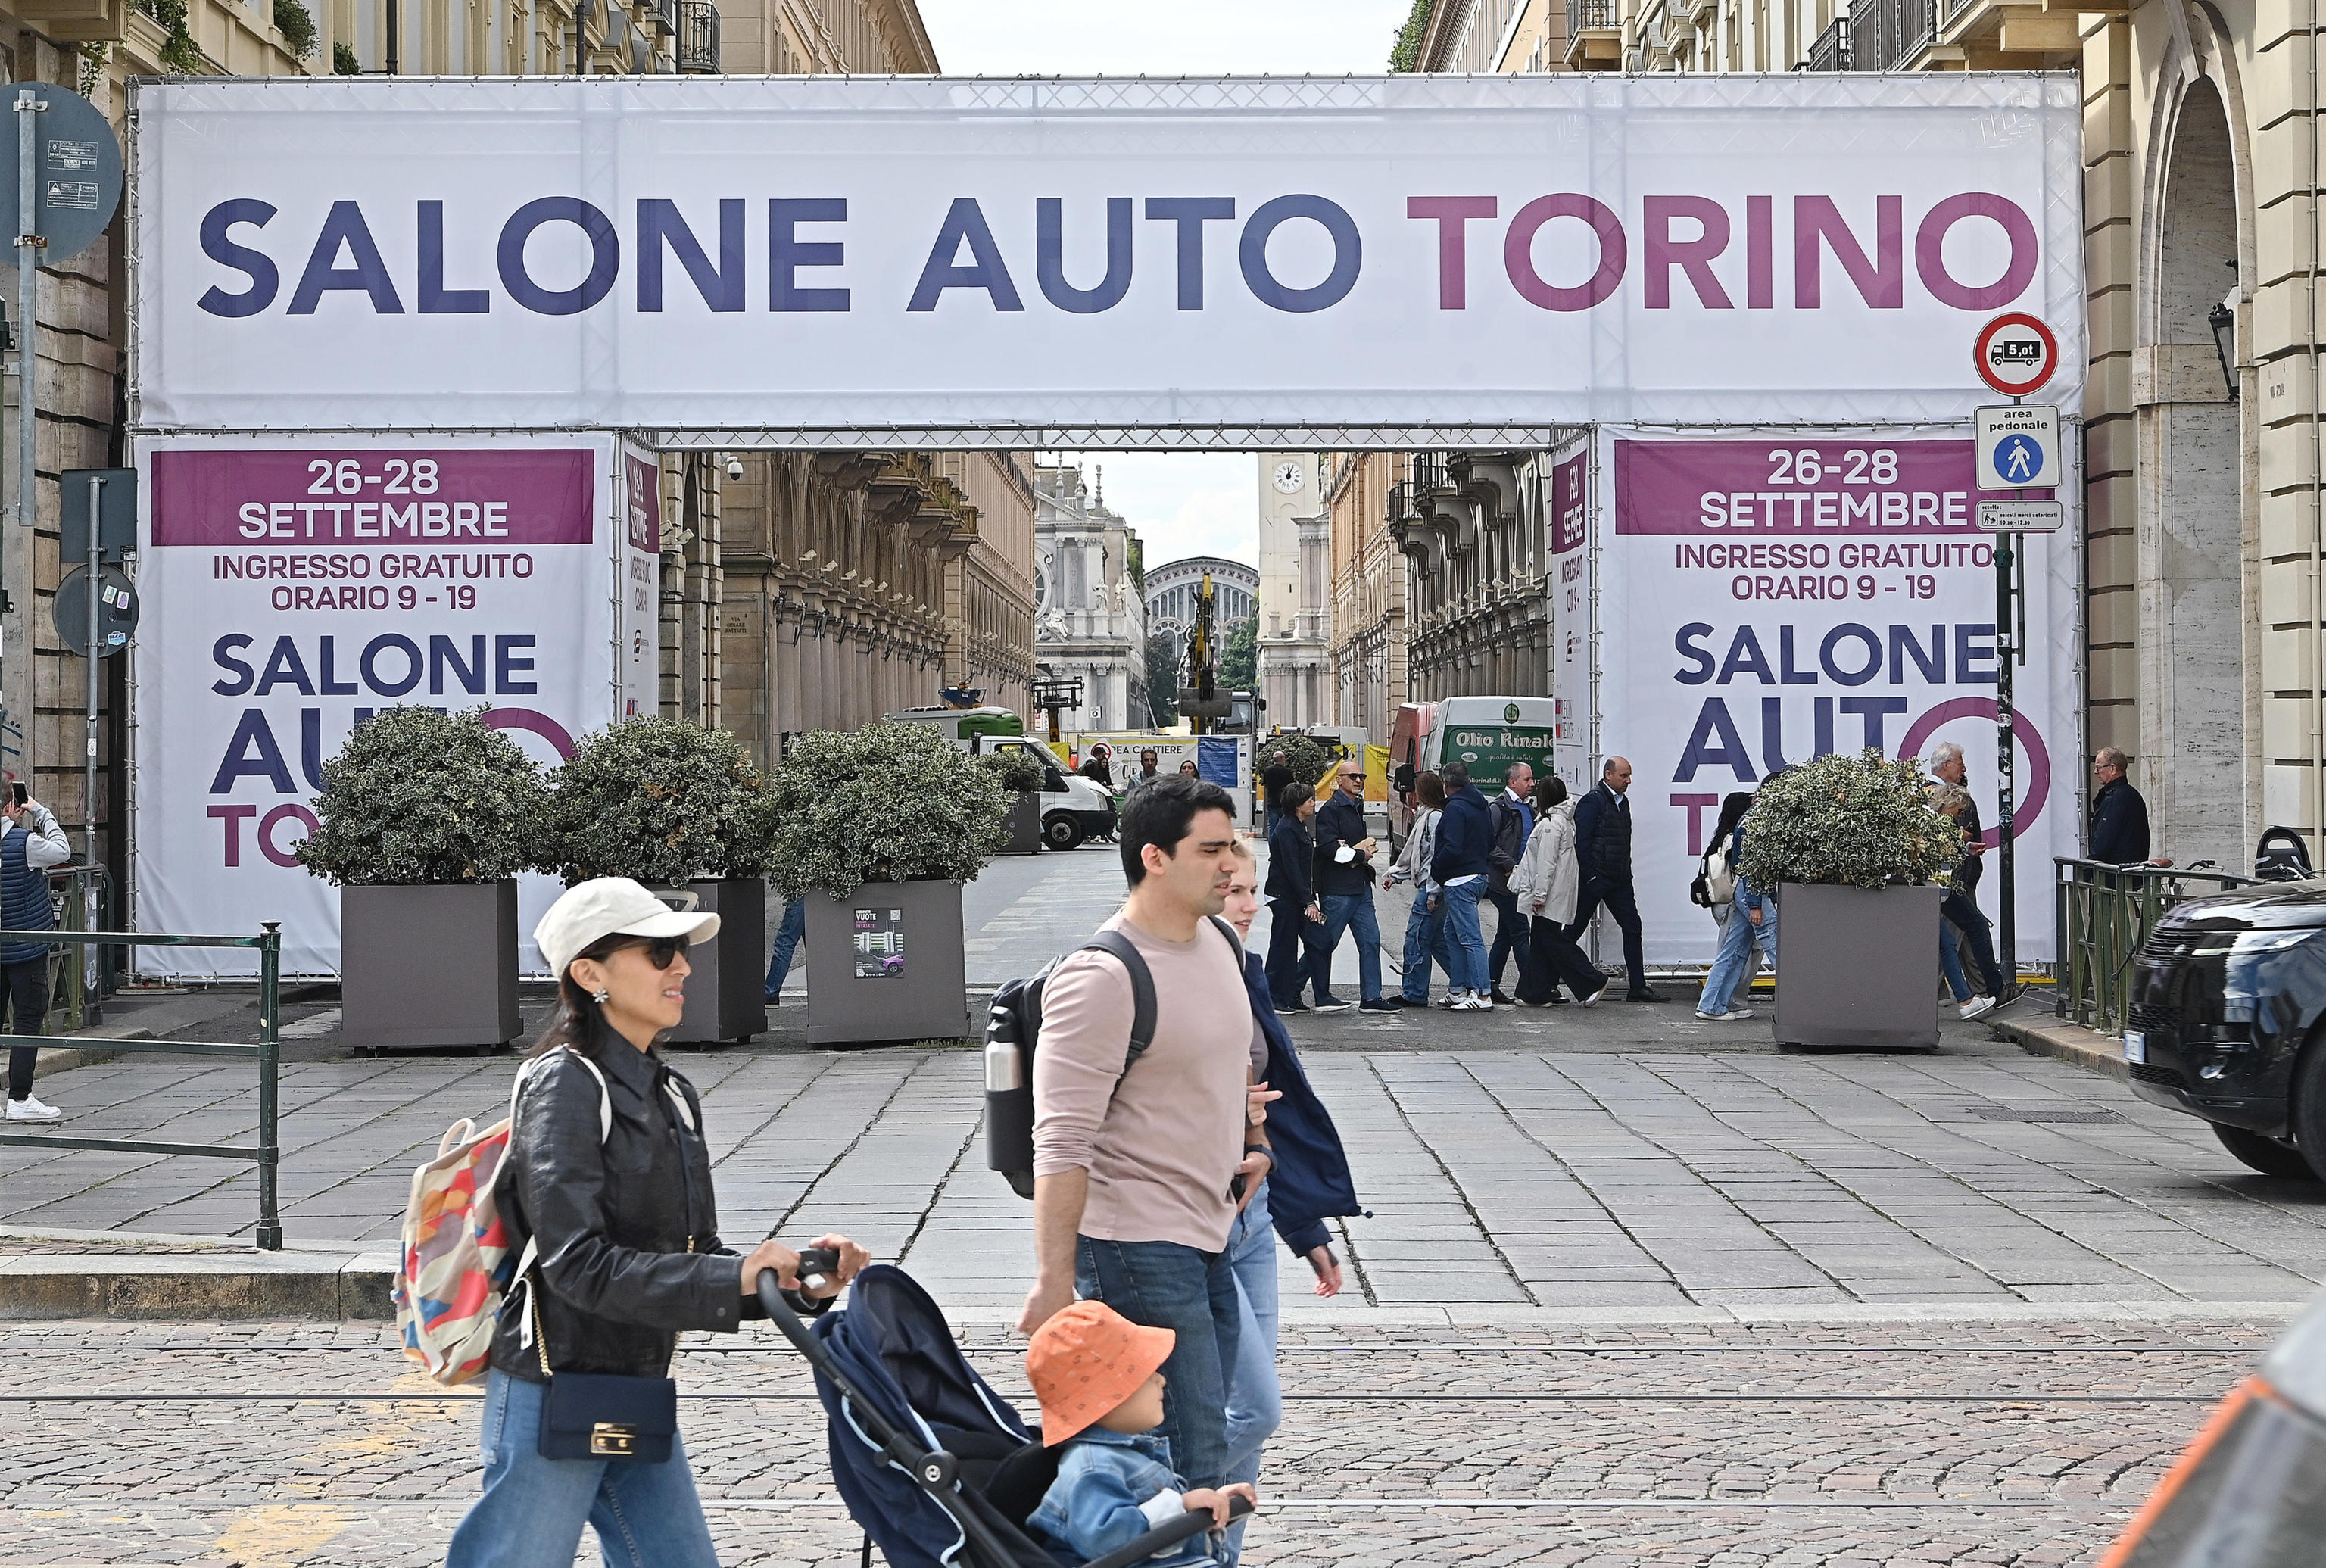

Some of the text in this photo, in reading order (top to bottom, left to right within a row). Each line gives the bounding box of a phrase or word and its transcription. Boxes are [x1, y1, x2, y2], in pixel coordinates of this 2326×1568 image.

[197, 192, 2038, 318] SALONE AUTO TORINO
[1989, 421, 2048, 433] pedonale
[307, 459, 439, 494] 26-28
[1767, 449, 1898, 485] 26-28
[239, 501, 509, 538] SETTEMBRE
[1700, 491, 1968, 528] SETTEMBRE
[214, 553, 533, 580] INGRESSO GRATUITO
[1676, 542, 1993, 569] INGRESSO GRATUITO
[271, 585, 389, 610] ORARIO
[398, 585, 416, 610] 9
[446, 585, 476, 610] 19
[1732, 575, 1849, 600] ORARIO
[1857, 575, 1875, 600] 9
[1904, 574, 1935, 600] 19
[211, 633, 538, 697] SALONE
[1673, 622, 1999, 685] SALONE
[1112, 745, 1130, 754] EA
[1455, 731, 1494, 747] Olio
